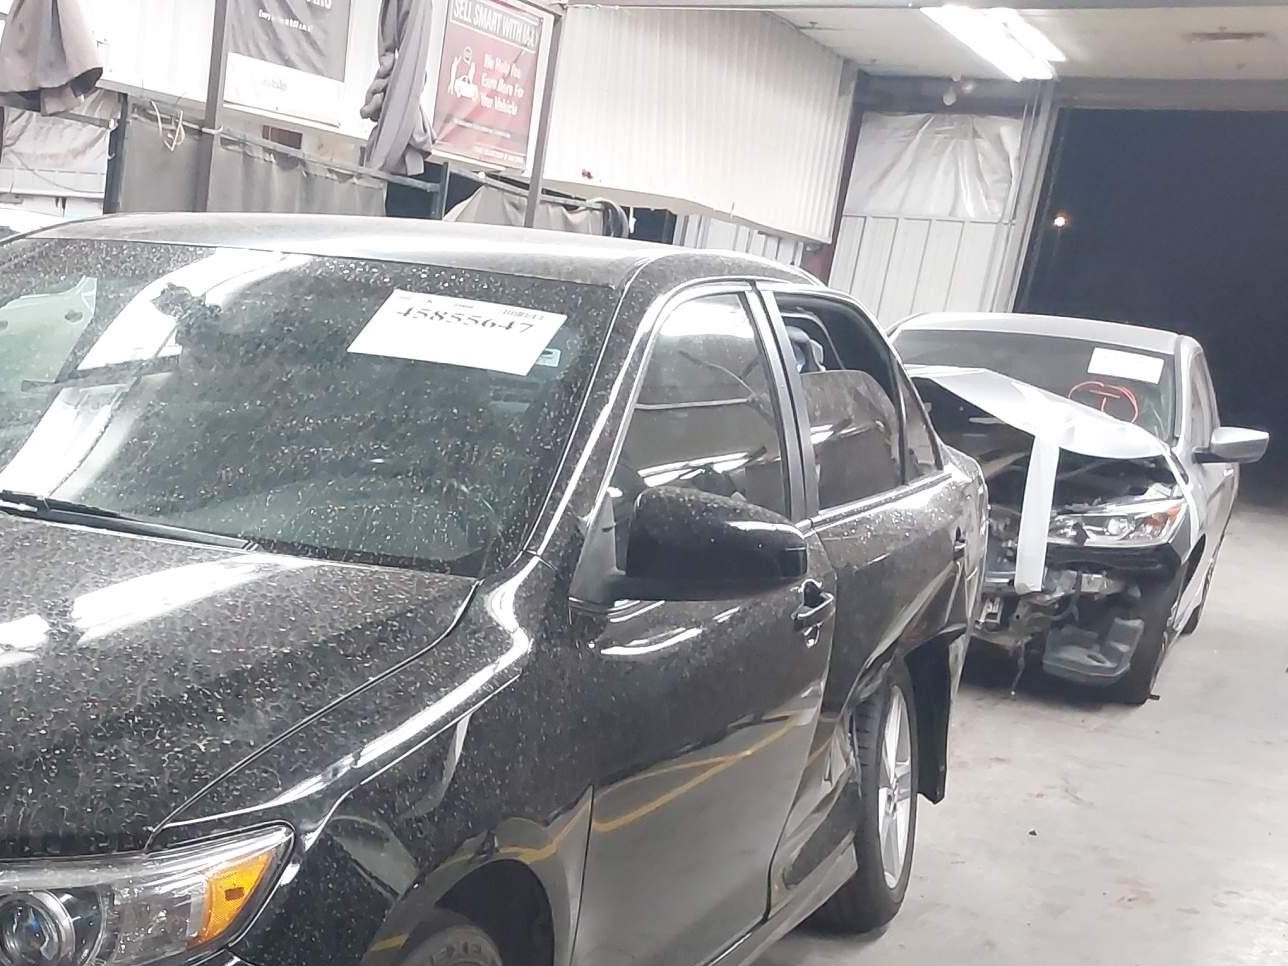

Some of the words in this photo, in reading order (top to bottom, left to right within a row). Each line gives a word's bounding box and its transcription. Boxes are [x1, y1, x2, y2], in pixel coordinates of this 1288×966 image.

[454, 0, 472, 23] SELL
[474, 5, 502, 33] SMART
[501, 14, 522, 41] WITH
[396, 306, 535, 334] 45855647
